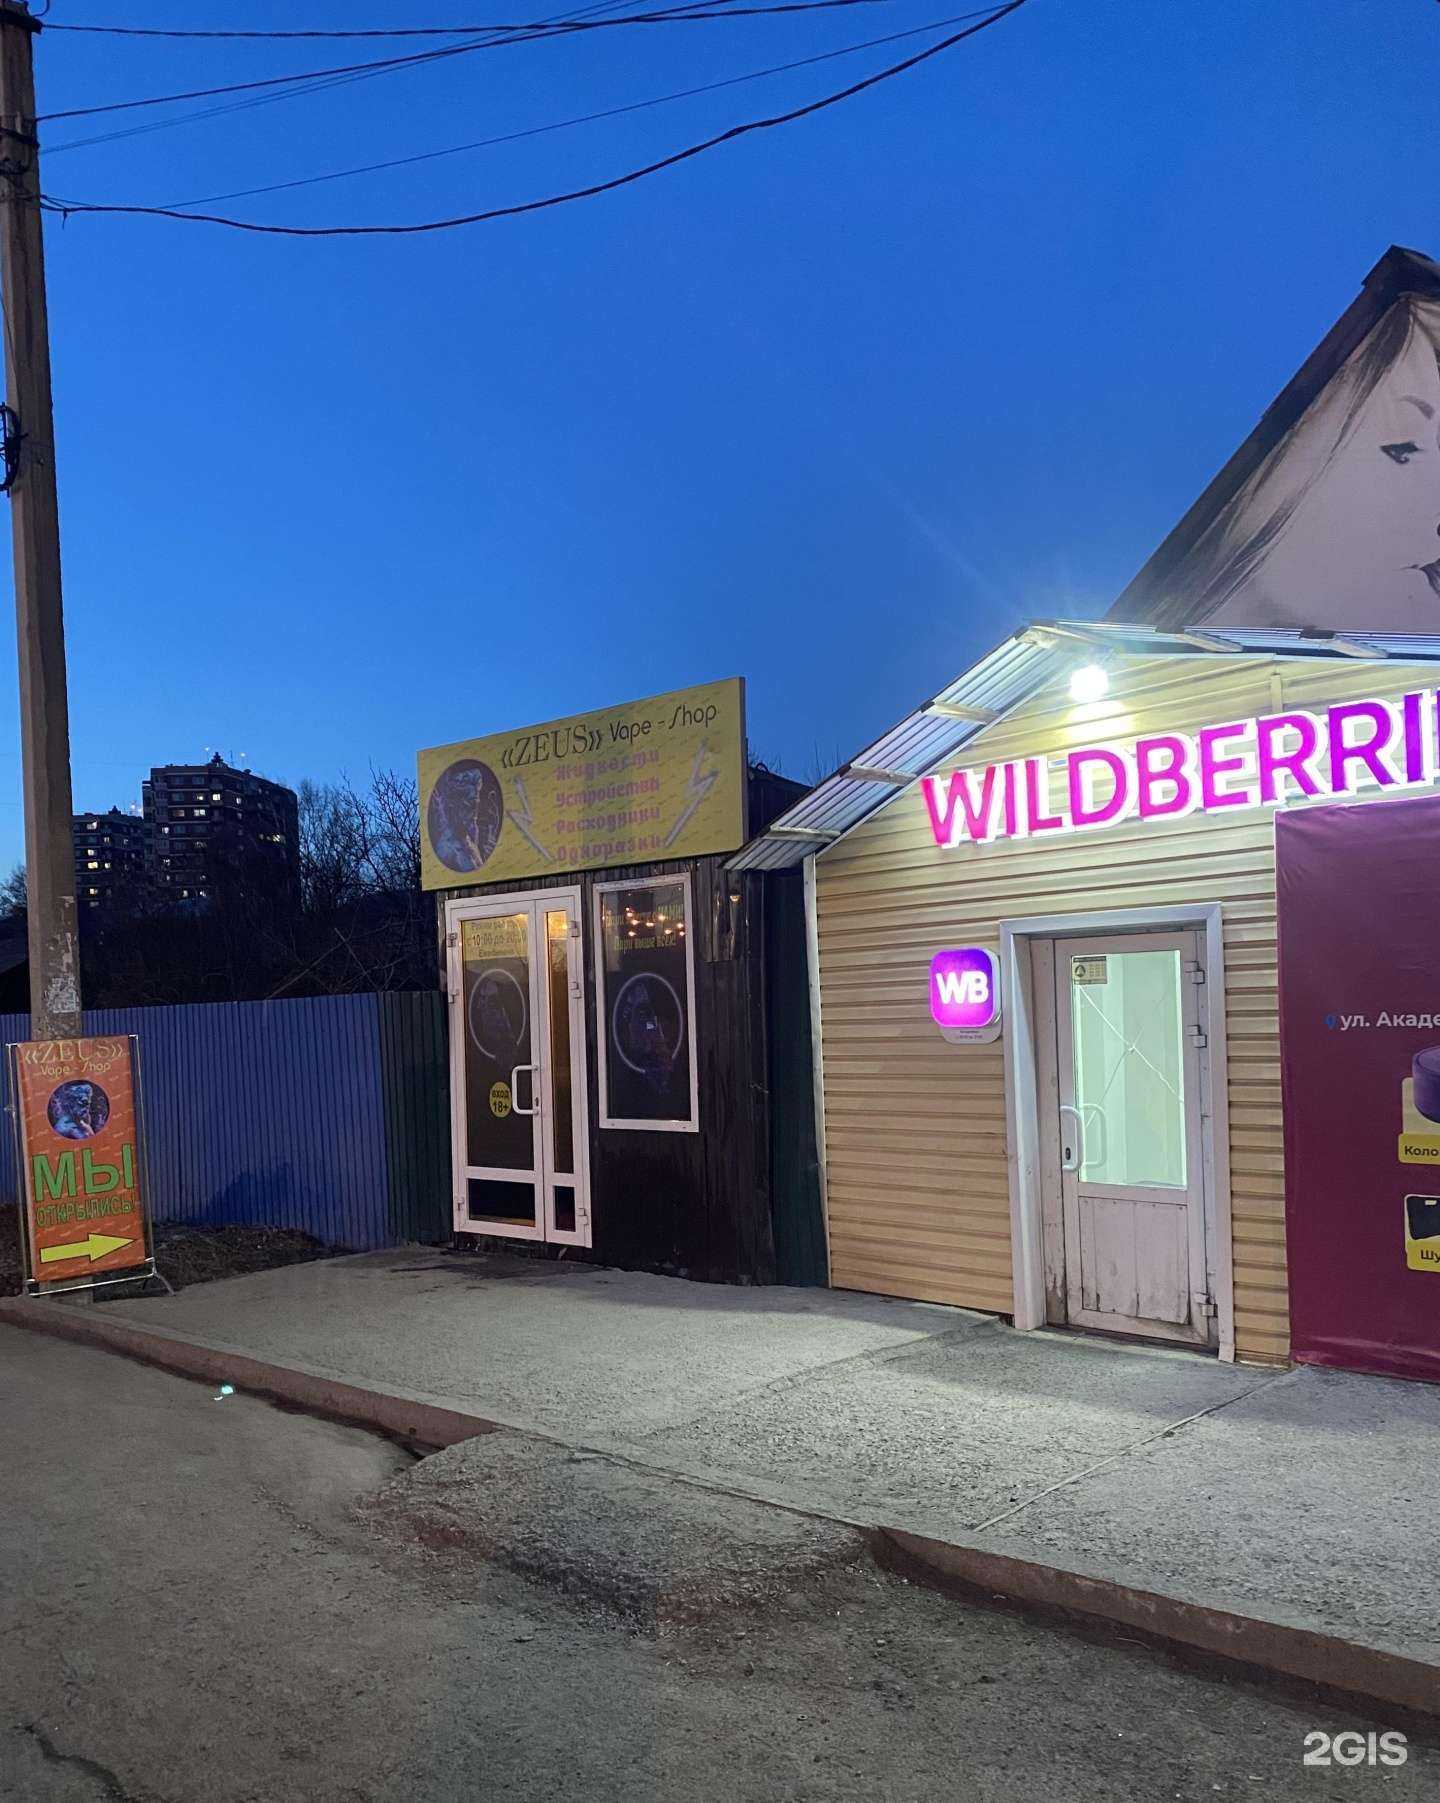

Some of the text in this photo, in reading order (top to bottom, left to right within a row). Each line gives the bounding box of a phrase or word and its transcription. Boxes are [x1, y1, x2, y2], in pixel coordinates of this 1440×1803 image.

[608, 717, 652, 745] Vape
[668, 702, 717, 730] Shop
[921, 687, 1440, 848] WILDBERRI
[935, 969, 990, 1007] WB
[1341, 1013, 1370, 1031] ул.
[40, 1061, 71, 1078] Vape
[493, 1101, 509, 1113] 18+
[31, 1143, 135, 1202] МЫ
